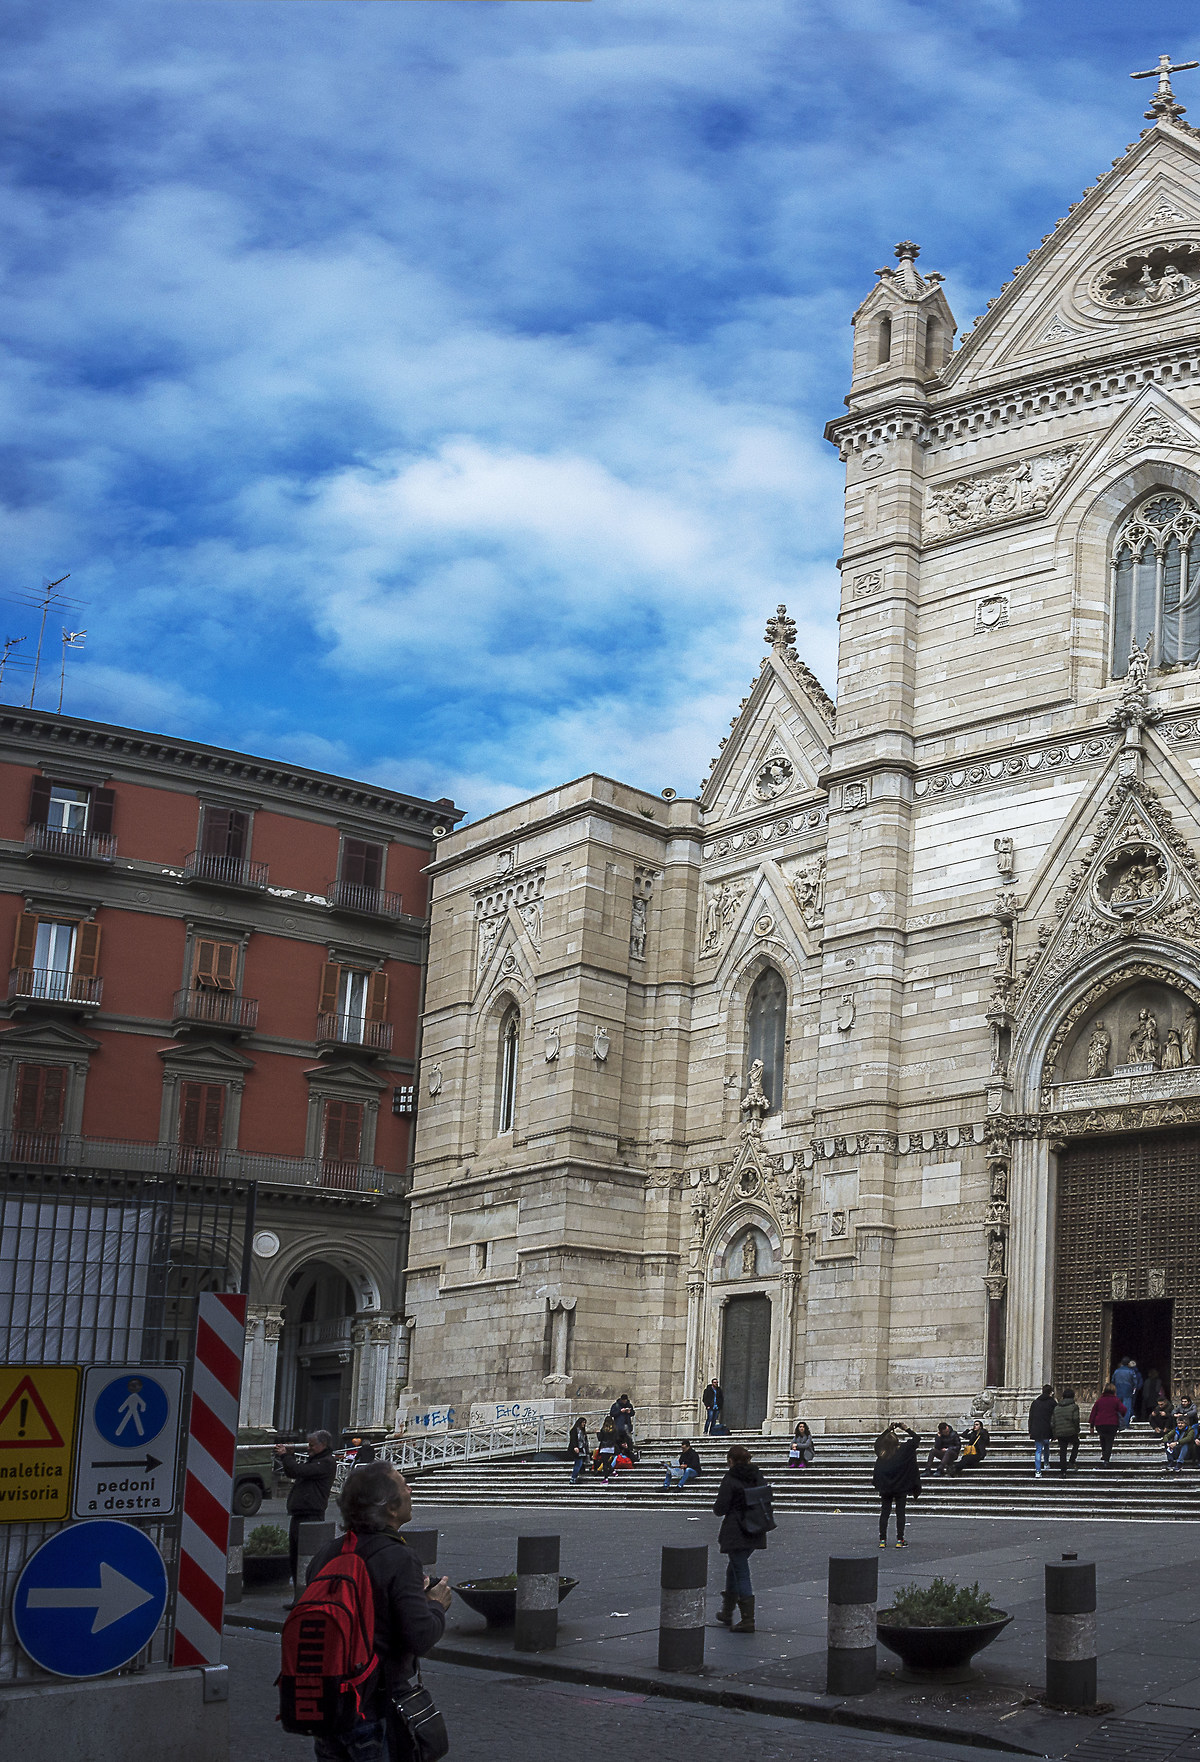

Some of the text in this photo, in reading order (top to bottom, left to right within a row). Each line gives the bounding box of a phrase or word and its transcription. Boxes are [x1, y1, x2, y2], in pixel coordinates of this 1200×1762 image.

[97, 1477, 155, 1495] pedoni
[88, 1495, 161, 1510] a destra
[295, 1620, 326, 1720] PUMA
